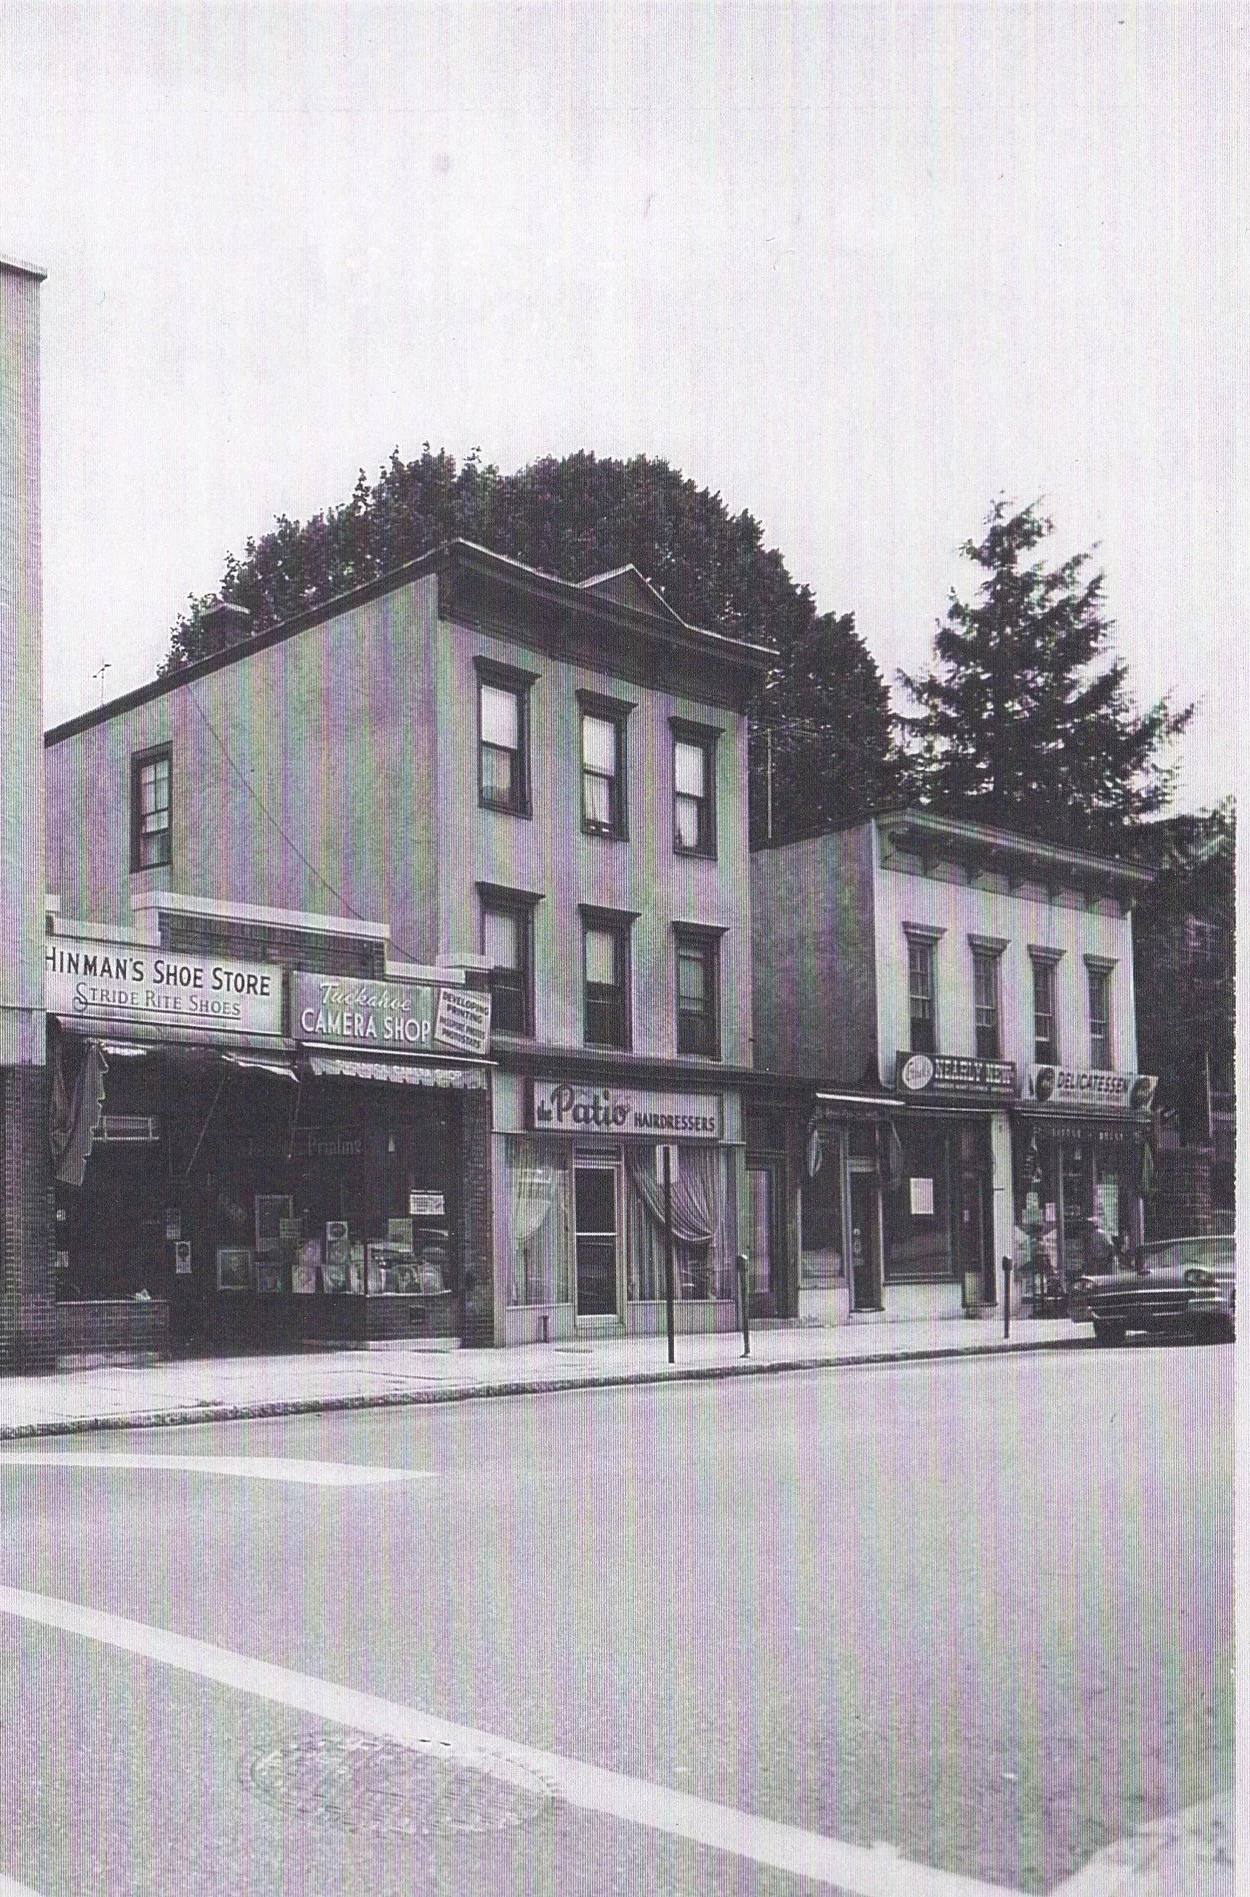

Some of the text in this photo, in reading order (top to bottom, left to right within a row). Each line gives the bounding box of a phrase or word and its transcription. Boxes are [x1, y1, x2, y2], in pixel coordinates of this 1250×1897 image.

[152, 959, 204, 989] SHOE
[211, 966, 272, 997] STORE
[73, 981, 242, 1016] STRIDE RITE SHOES
[320, 981, 412, 1011] Tuckahoe
[300, 1007, 431, 1042] CAMERA SHOP
[1057, 1070, 1129, 1094] DELICATESSEN
[550, 1083, 631, 1127] Patio
[633, 1111, 717, 1132] HAIRDRESSERS
